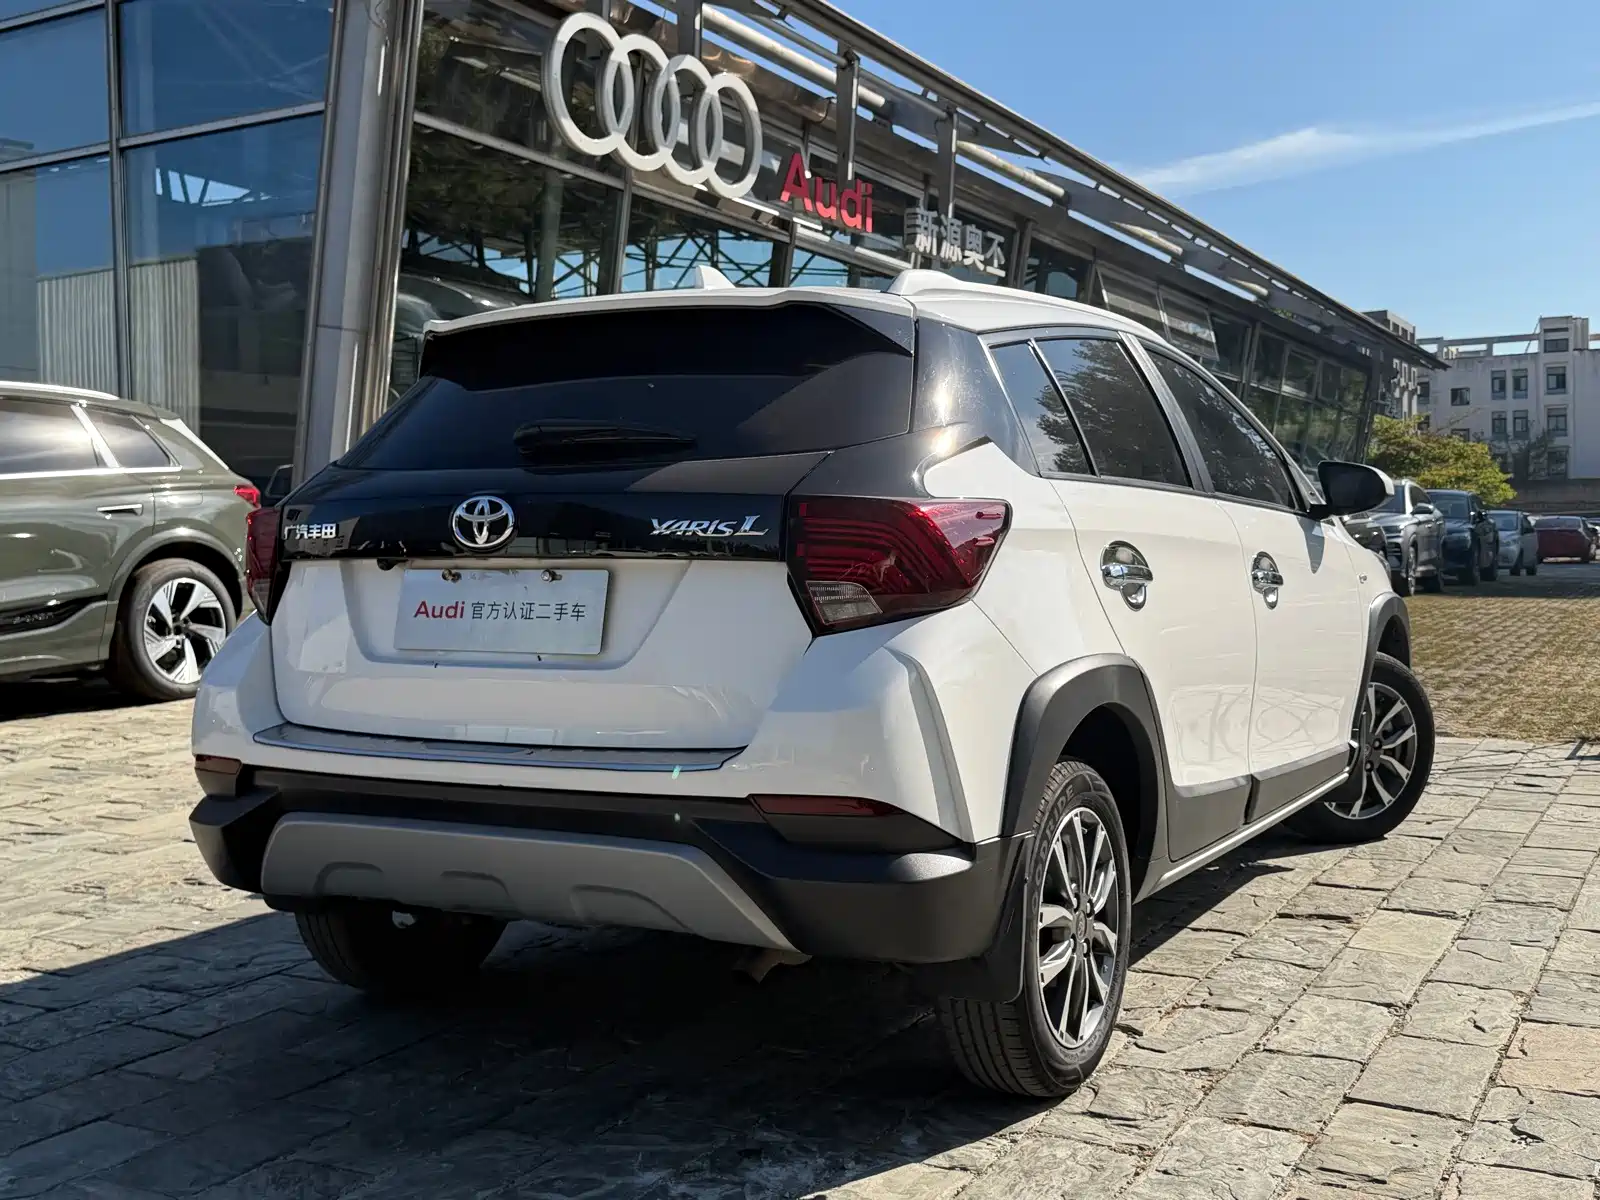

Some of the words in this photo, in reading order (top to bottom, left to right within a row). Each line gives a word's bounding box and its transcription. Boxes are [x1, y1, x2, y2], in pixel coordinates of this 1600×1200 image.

[780, 152, 873, 233] Audi
[283, 523, 337, 540] 广汽丰田
[649, 517, 738, 537] YARIS
[733, 514, 769, 536] L
[413, 600, 466, 619] Audi
[470, 601, 587, 622] 官方认证二手车
[1030, 783, 1075, 942] OODRIDE
